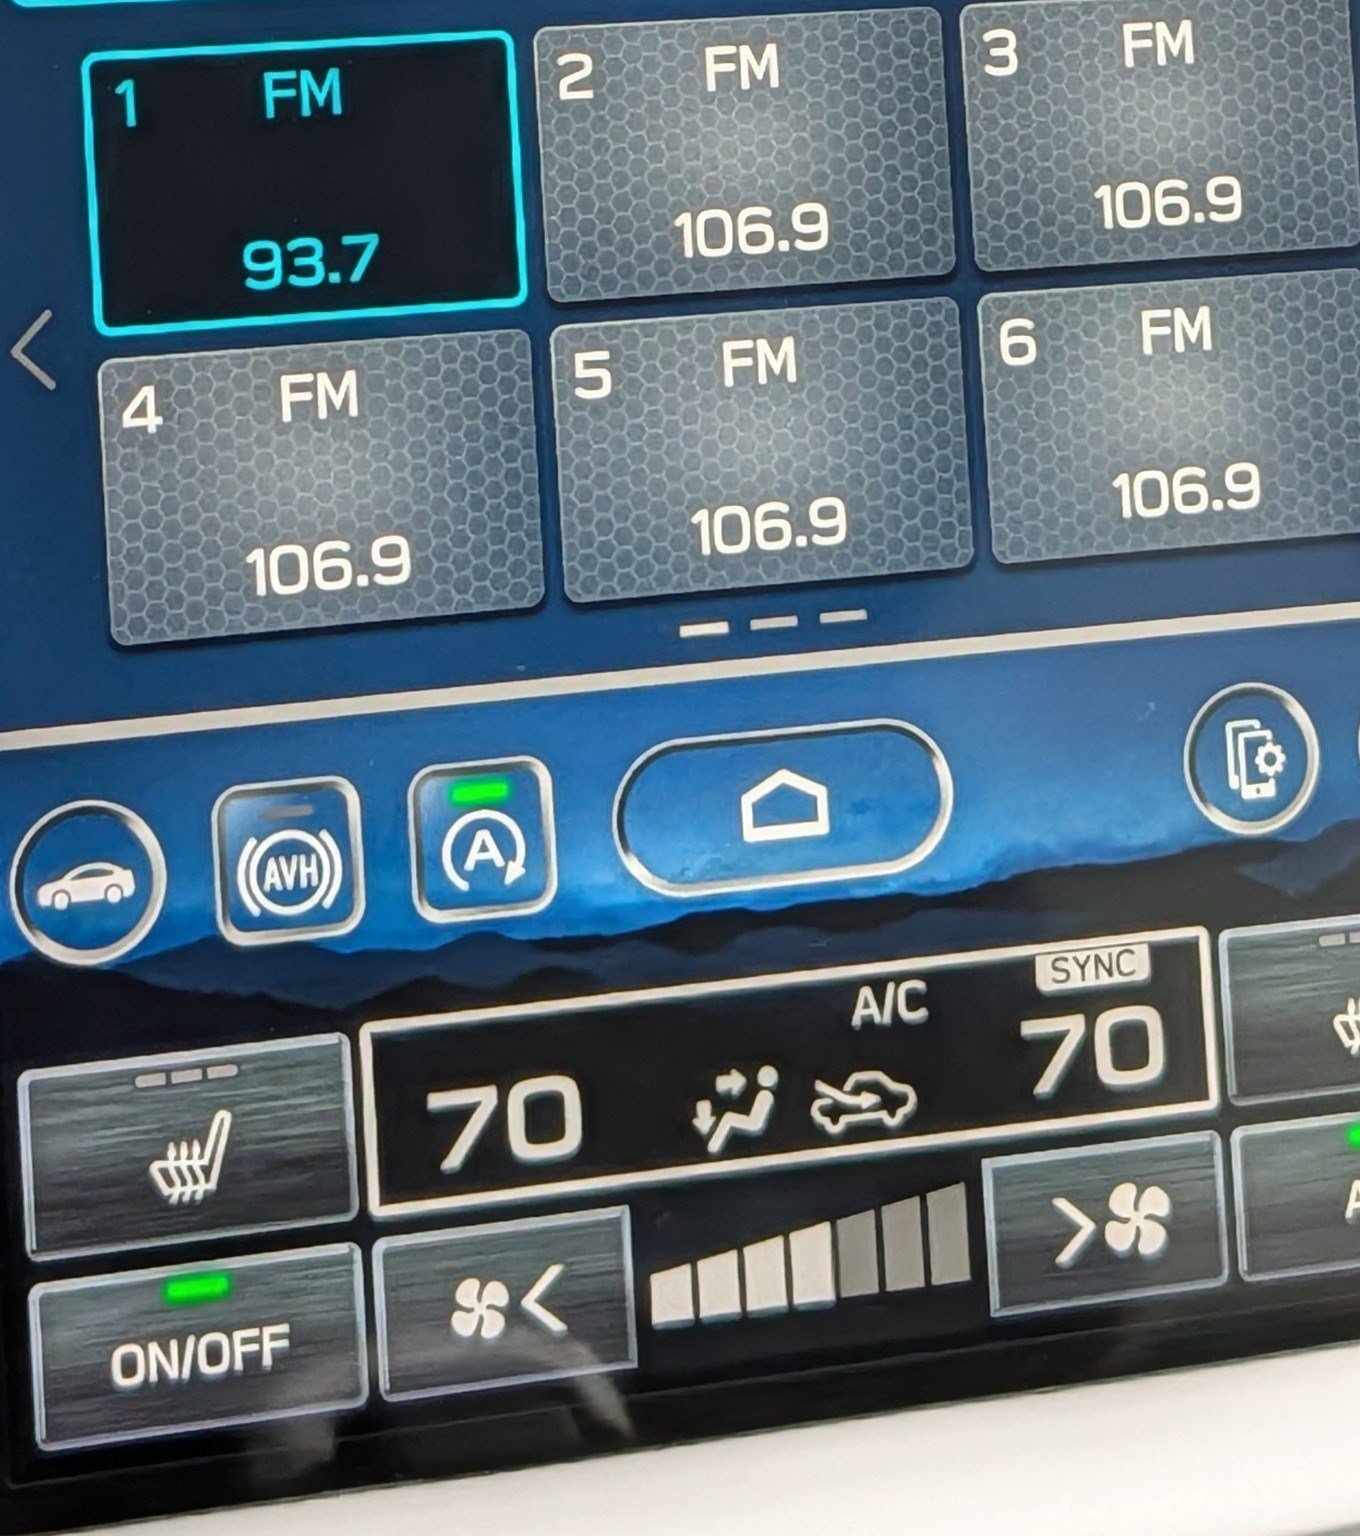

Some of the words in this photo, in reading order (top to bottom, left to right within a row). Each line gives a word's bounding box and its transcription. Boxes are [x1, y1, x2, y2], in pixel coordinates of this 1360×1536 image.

[704, 43, 779, 92] FM
[982, 28, 1018, 76] 3
[1122, 20, 1194, 68] FM
[263, 68, 342, 119] FM
[556, 53, 594, 100] 2
[115, 79, 138, 127] 1
[1094, 176, 1242, 229] 106.9
[674, 203, 830, 258] 106.9
[242, 234, 380, 290] 93.7
[999, 318, 1037, 366] 6
[1140, 306, 1212, 355] FM
[573, 350, 612, 398] 5
[721, 337, 796, 387] FM
[122, 385, 163, 433] 4
[280, 370, 358, 423] FM
[1112, 462, 1261, 519] 106.9
[691, 497, 846, 555] 106.9
[245, 535, 411, 596] 106.9
[261, 853, 320, 893] AVH
[1049, 948, 1137, 985] SYNC
[850, 980, 929, 1027] A/C
[1020, 1006, 1165, 1099] 70
[427, 1075, 584, 1173] 70
[110, 1323, 291, 1390] ON/OFF
